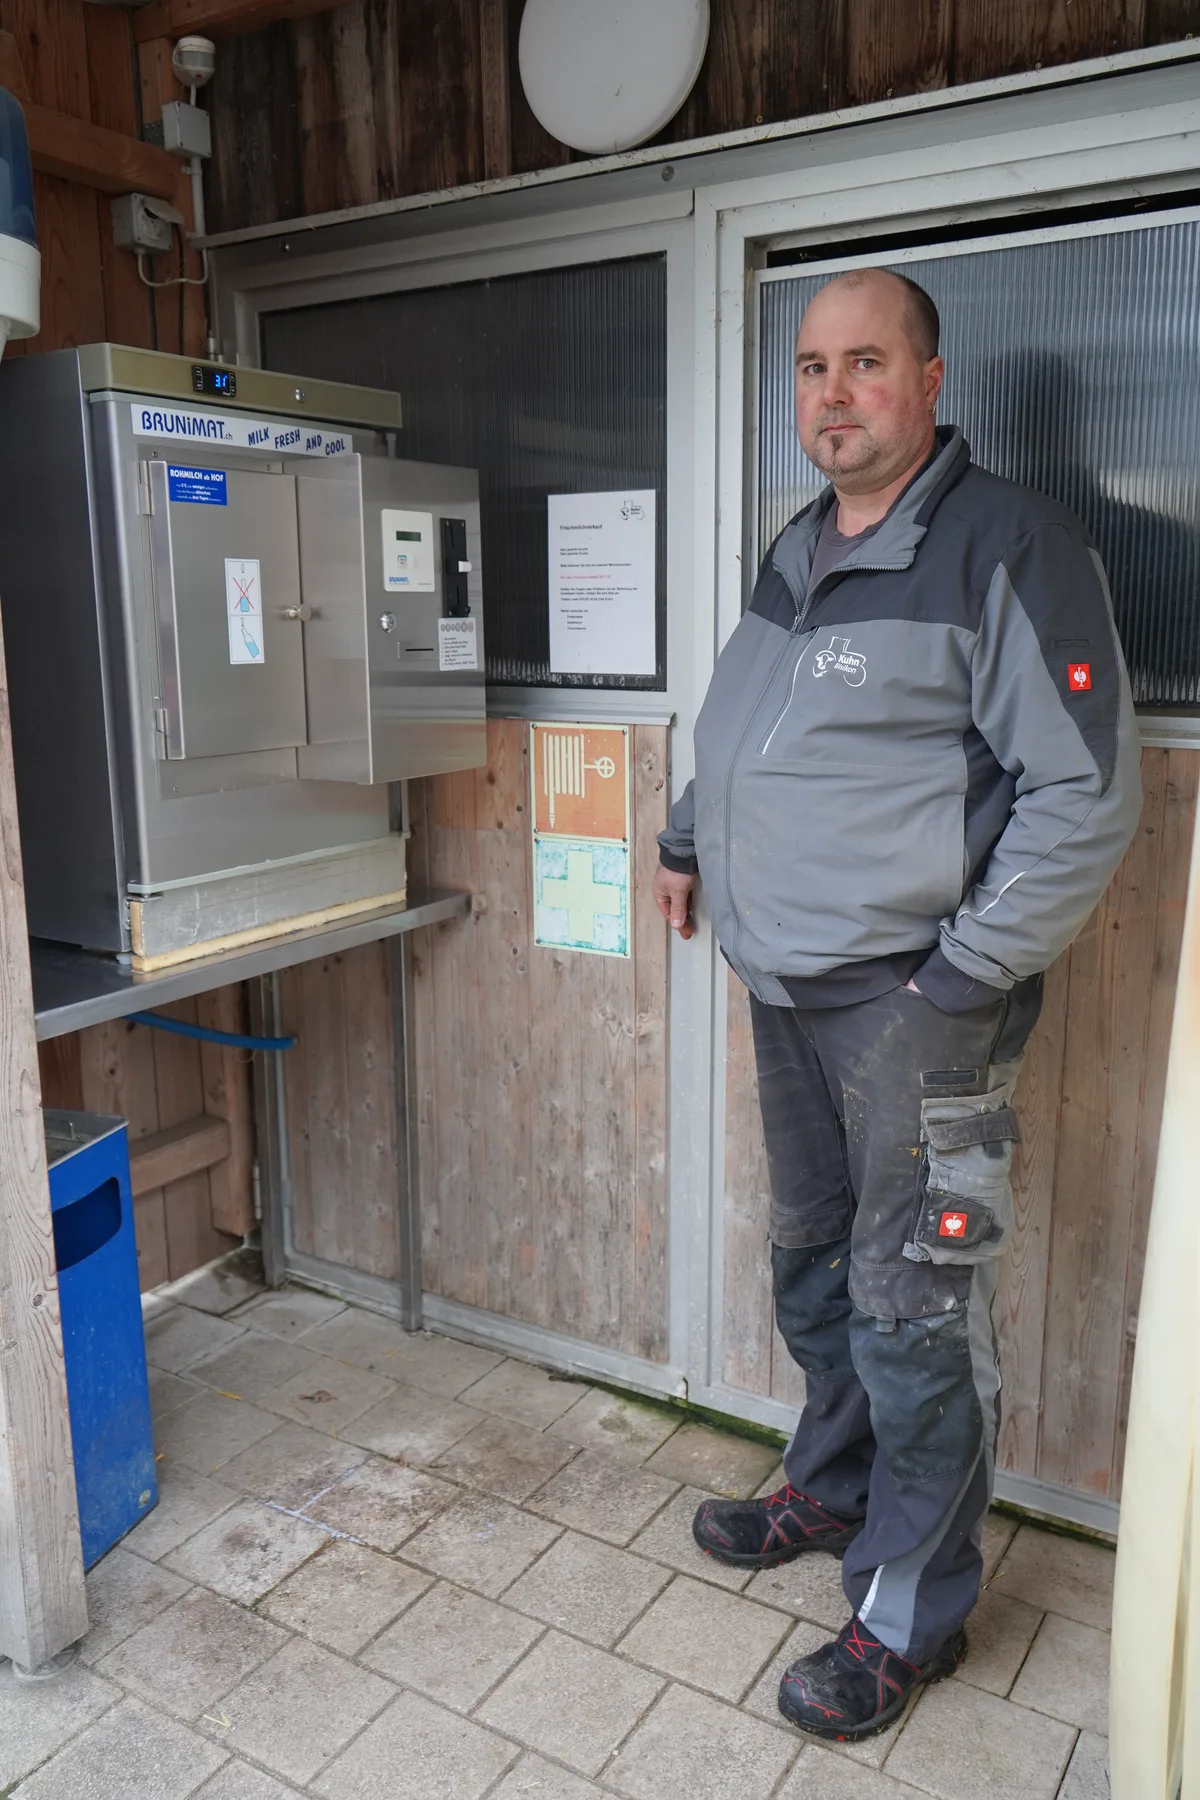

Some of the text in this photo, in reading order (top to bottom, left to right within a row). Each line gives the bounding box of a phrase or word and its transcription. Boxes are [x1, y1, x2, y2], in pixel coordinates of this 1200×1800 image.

[248, 427, 270, 446] MILK
[274, 429, 301, 449] FRESH
[306, 434, 322, 451] AND
[325, 438, 345, 456] COOL
[170, 469, 203, 480] ROHMILCH
[211, 473, 224, 482] HOF
[838, 654, 860, 667] Kuhn
[833, 662, 857, 674] Bisikon
